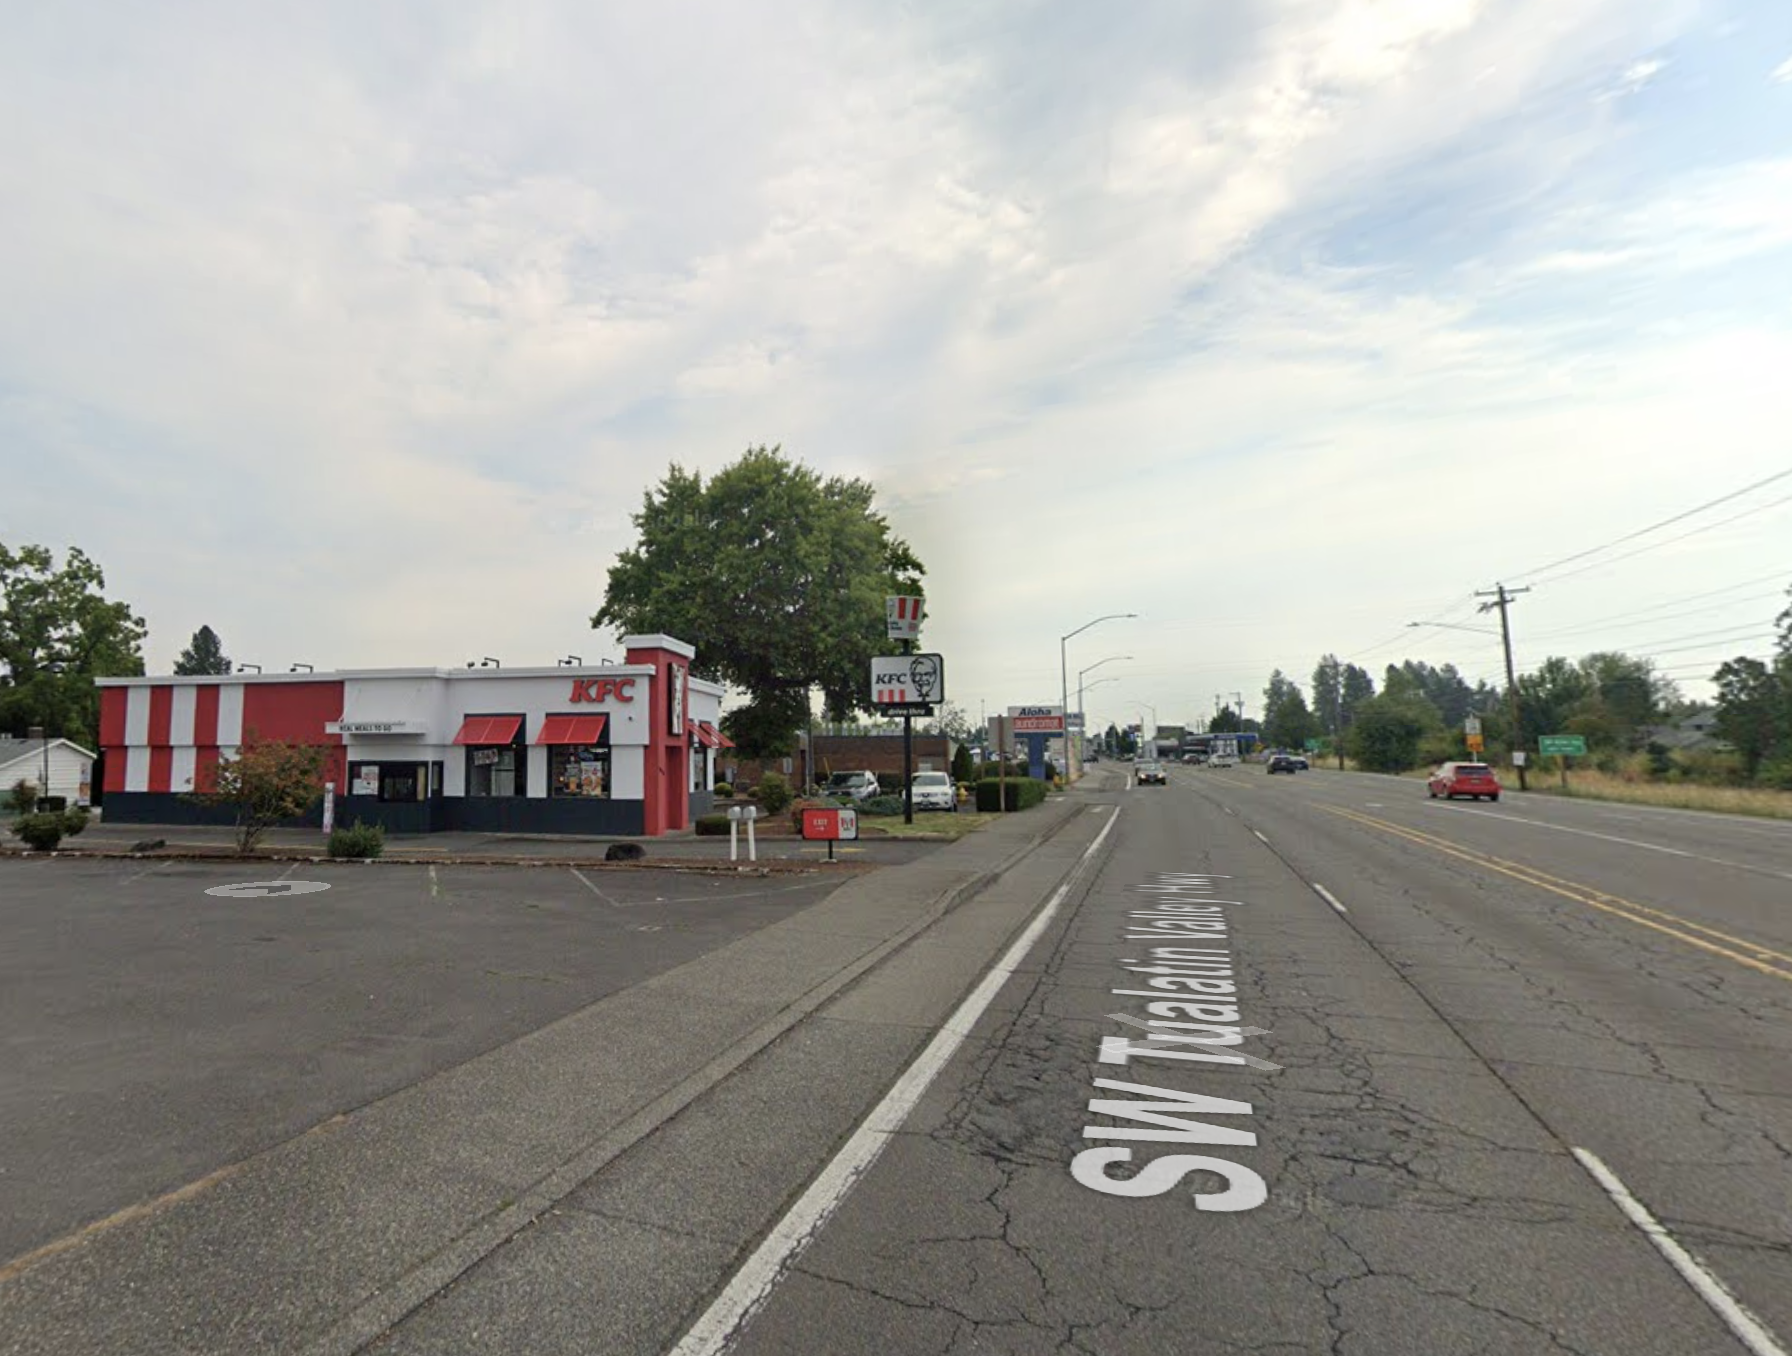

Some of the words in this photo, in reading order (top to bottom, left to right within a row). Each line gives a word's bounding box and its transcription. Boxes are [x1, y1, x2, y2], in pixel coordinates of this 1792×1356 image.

[875, 673, 907, 684] KFC
[569, 678, 636, 703] KFC
[1019, 707, 1052, 716] Aloha
